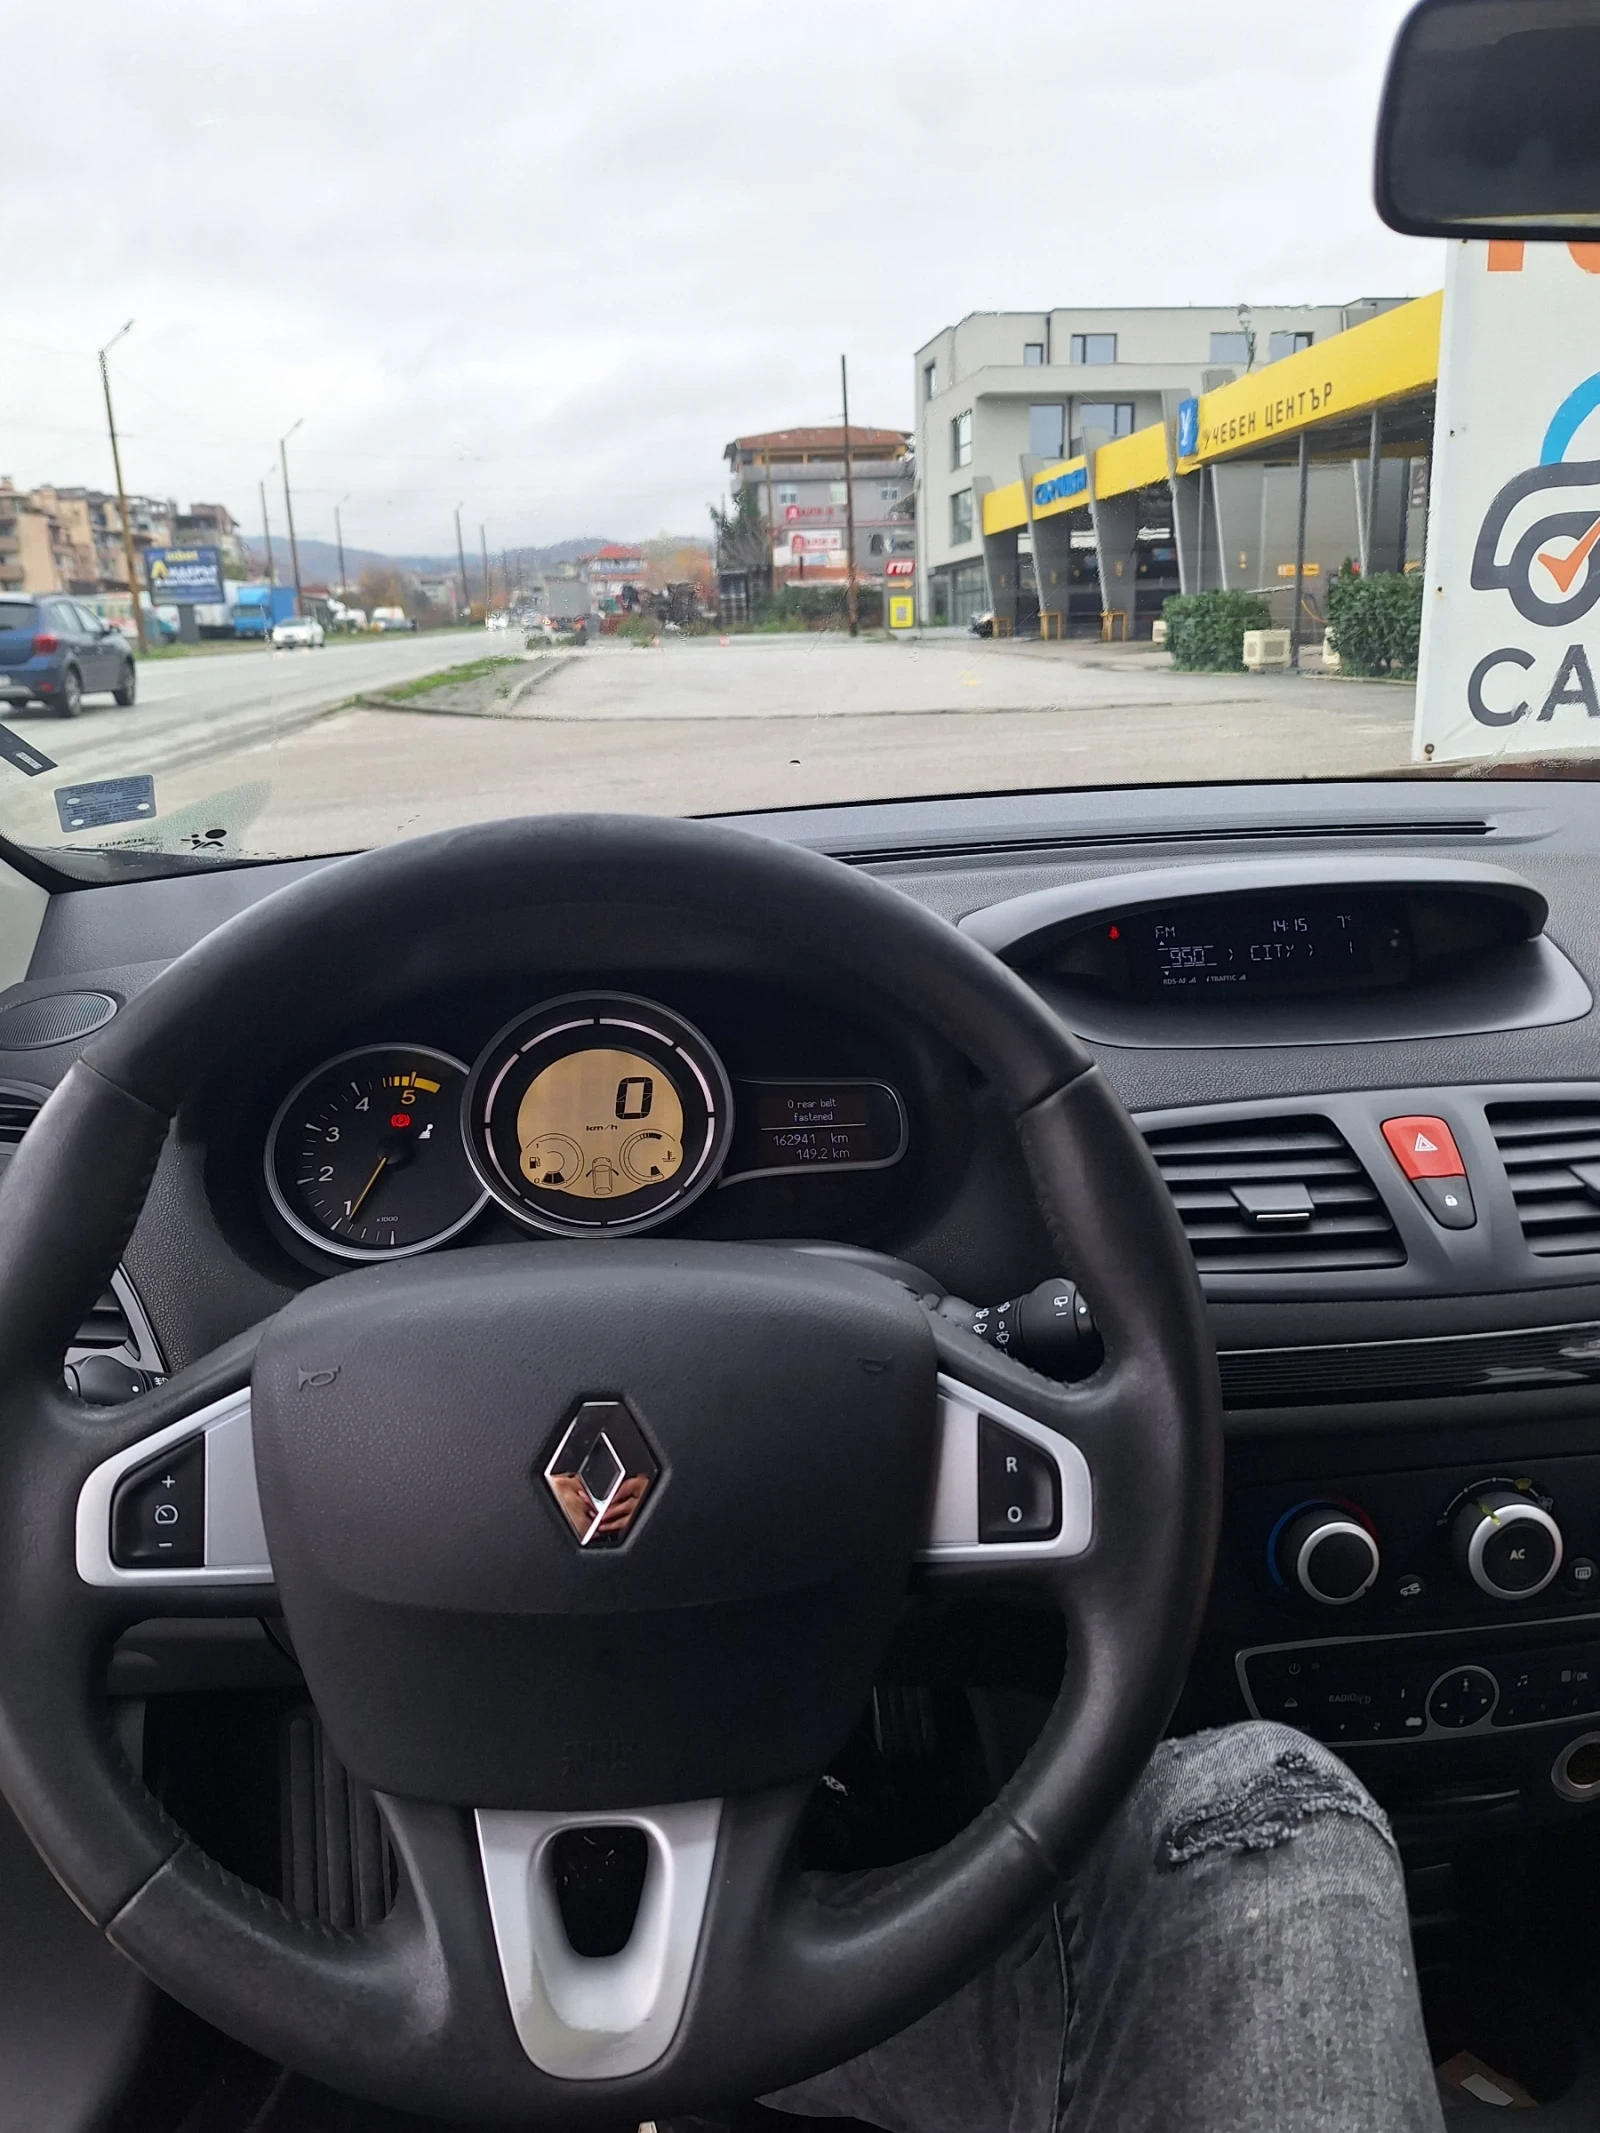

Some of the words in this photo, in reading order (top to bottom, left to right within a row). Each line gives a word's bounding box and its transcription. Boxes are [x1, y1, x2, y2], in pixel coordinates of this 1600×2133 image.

[1265, 382, 1333, 430] ЦЕНТЪР
[1154, 925, 1176, 939] FM
[1272, 918, 1308, 932] 14:15
[1250, 943, 1295, 961] CITY
[355, 1097, 370, 1112] 4
[400, 1089, 416, 1105] 5
[615, 1076, 654, 1120] 0
[797, 1100, 817, 1109] rear
[820, 1097, 837, 1108] belt
[794, 1111, 833, 1122] fastened
[325, 1127, 341, 1143] 3
[585, 1124, 618, 1132] km/h
[773, 1133, 816, 1147] 162941
[830, 1132, 849, 1144] km
[796, 1147, 828, 1160] 149.2
[832, 1147, 850, 1159] km
[318, 1166, 335, 1182] 2
[343, 1200, 353, 1216] 1
[1006, 1456, 1018, 1473] R
[1509, 1548, 1526, 1561] AC
